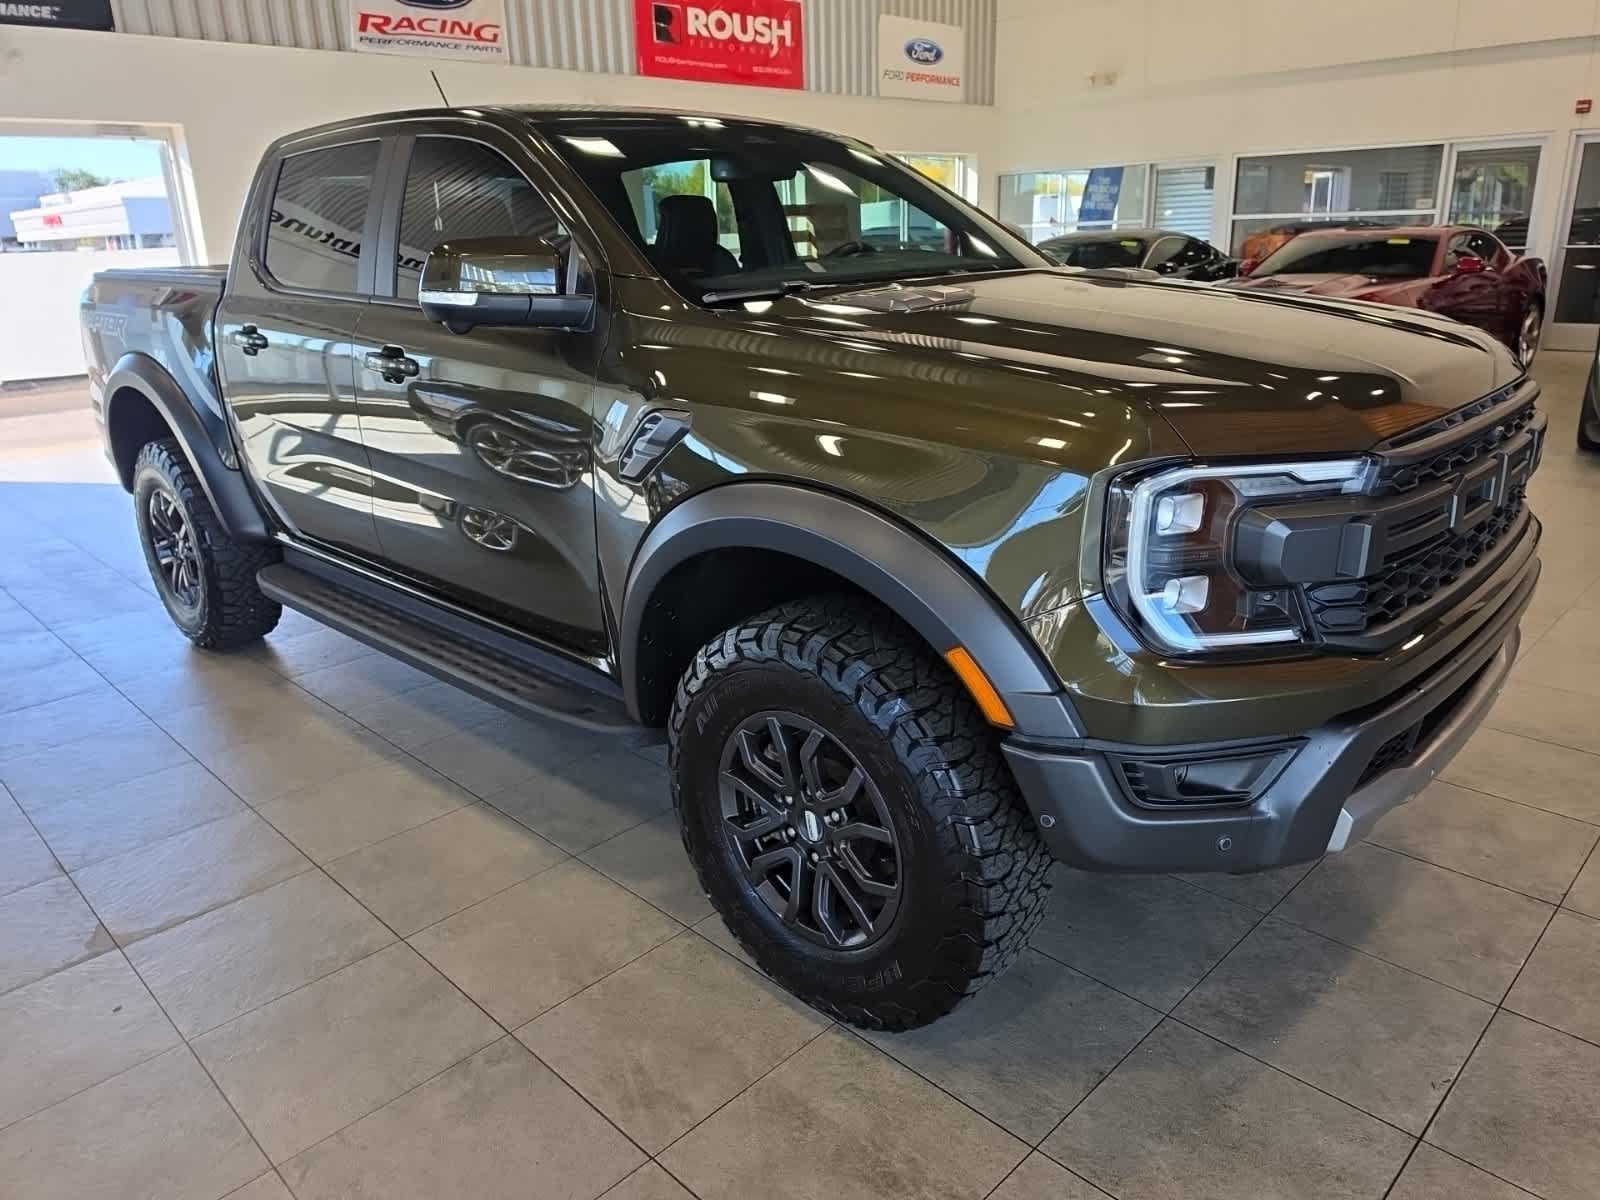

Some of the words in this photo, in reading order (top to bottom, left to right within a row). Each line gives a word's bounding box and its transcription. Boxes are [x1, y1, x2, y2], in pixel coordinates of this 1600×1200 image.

[358, 12, 500, 43] RACING
[687, 6, 792, 58] ROUSH
[360, 36, 462, 50] PERFORMANCE
[465, 45, 503, 54] PARTS
[882, 69, 904, 81] FORD
[904, 72, 961, 87] PERFORMANCE
